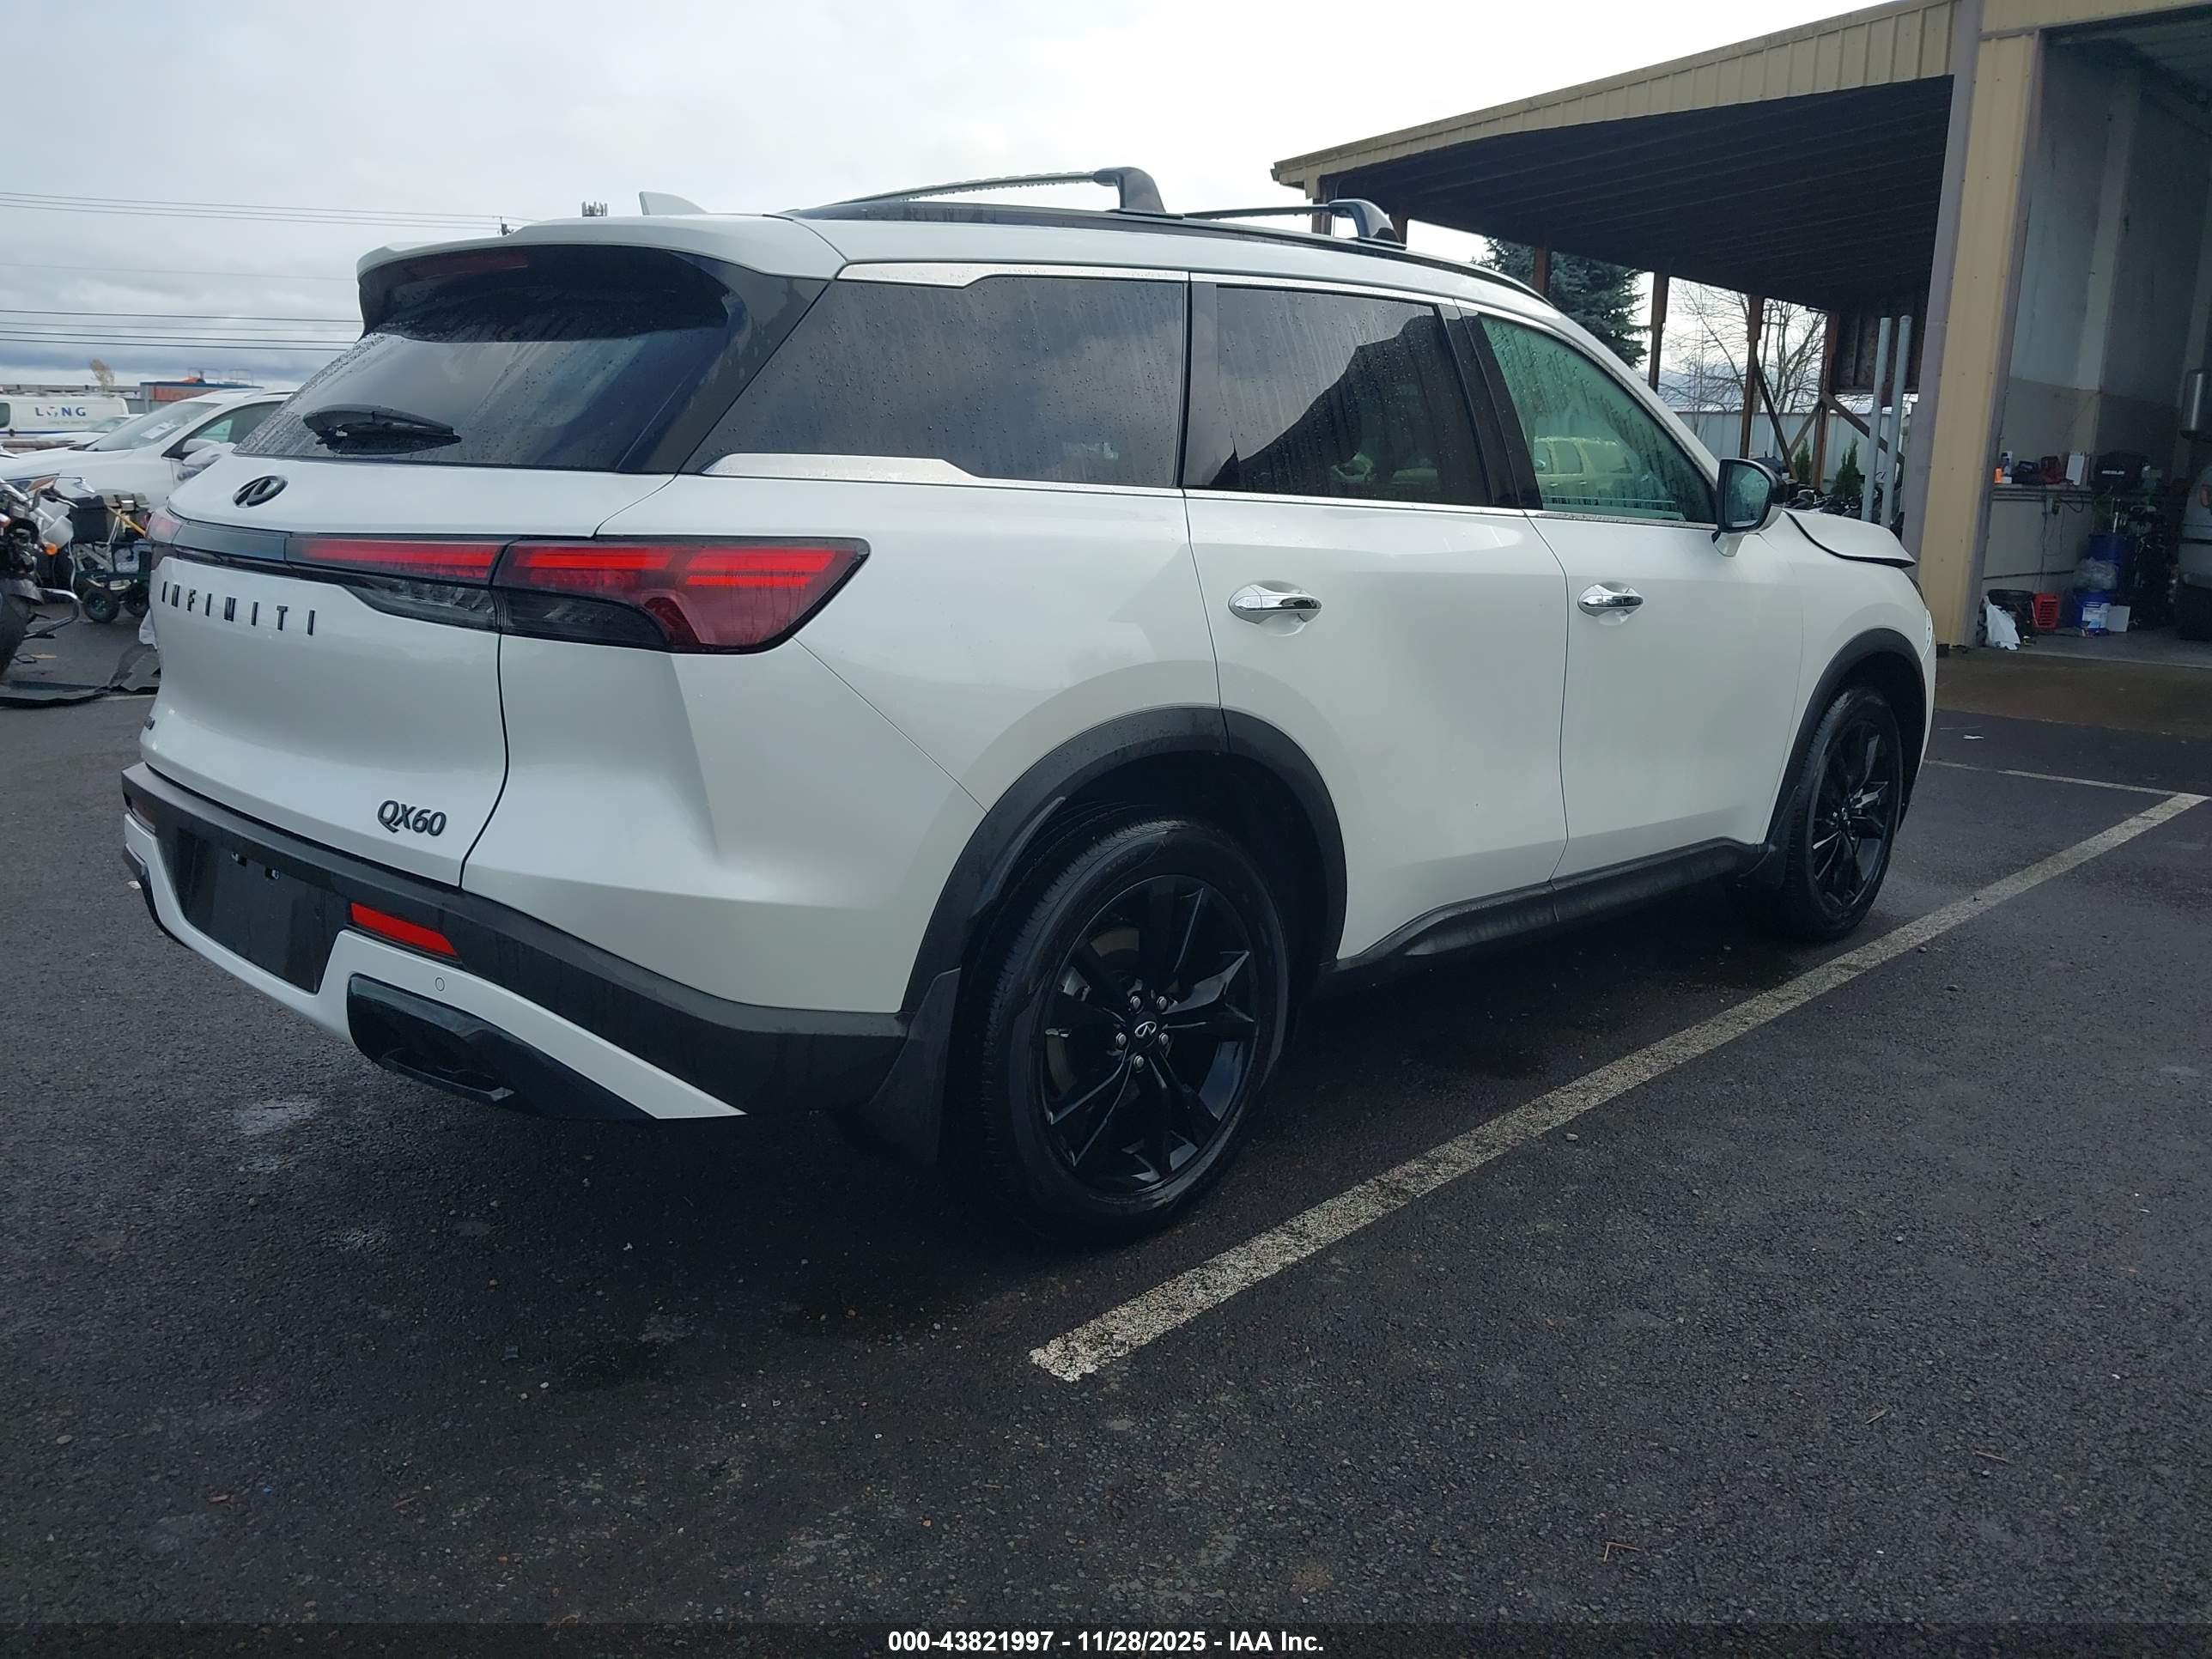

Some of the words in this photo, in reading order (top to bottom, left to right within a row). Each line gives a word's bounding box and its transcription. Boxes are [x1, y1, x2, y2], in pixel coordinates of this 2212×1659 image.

[35, 406, 87, 417] LONG
[161, 580, 316, 636] INFINITI
[378, 799, 447, 836] QX60
